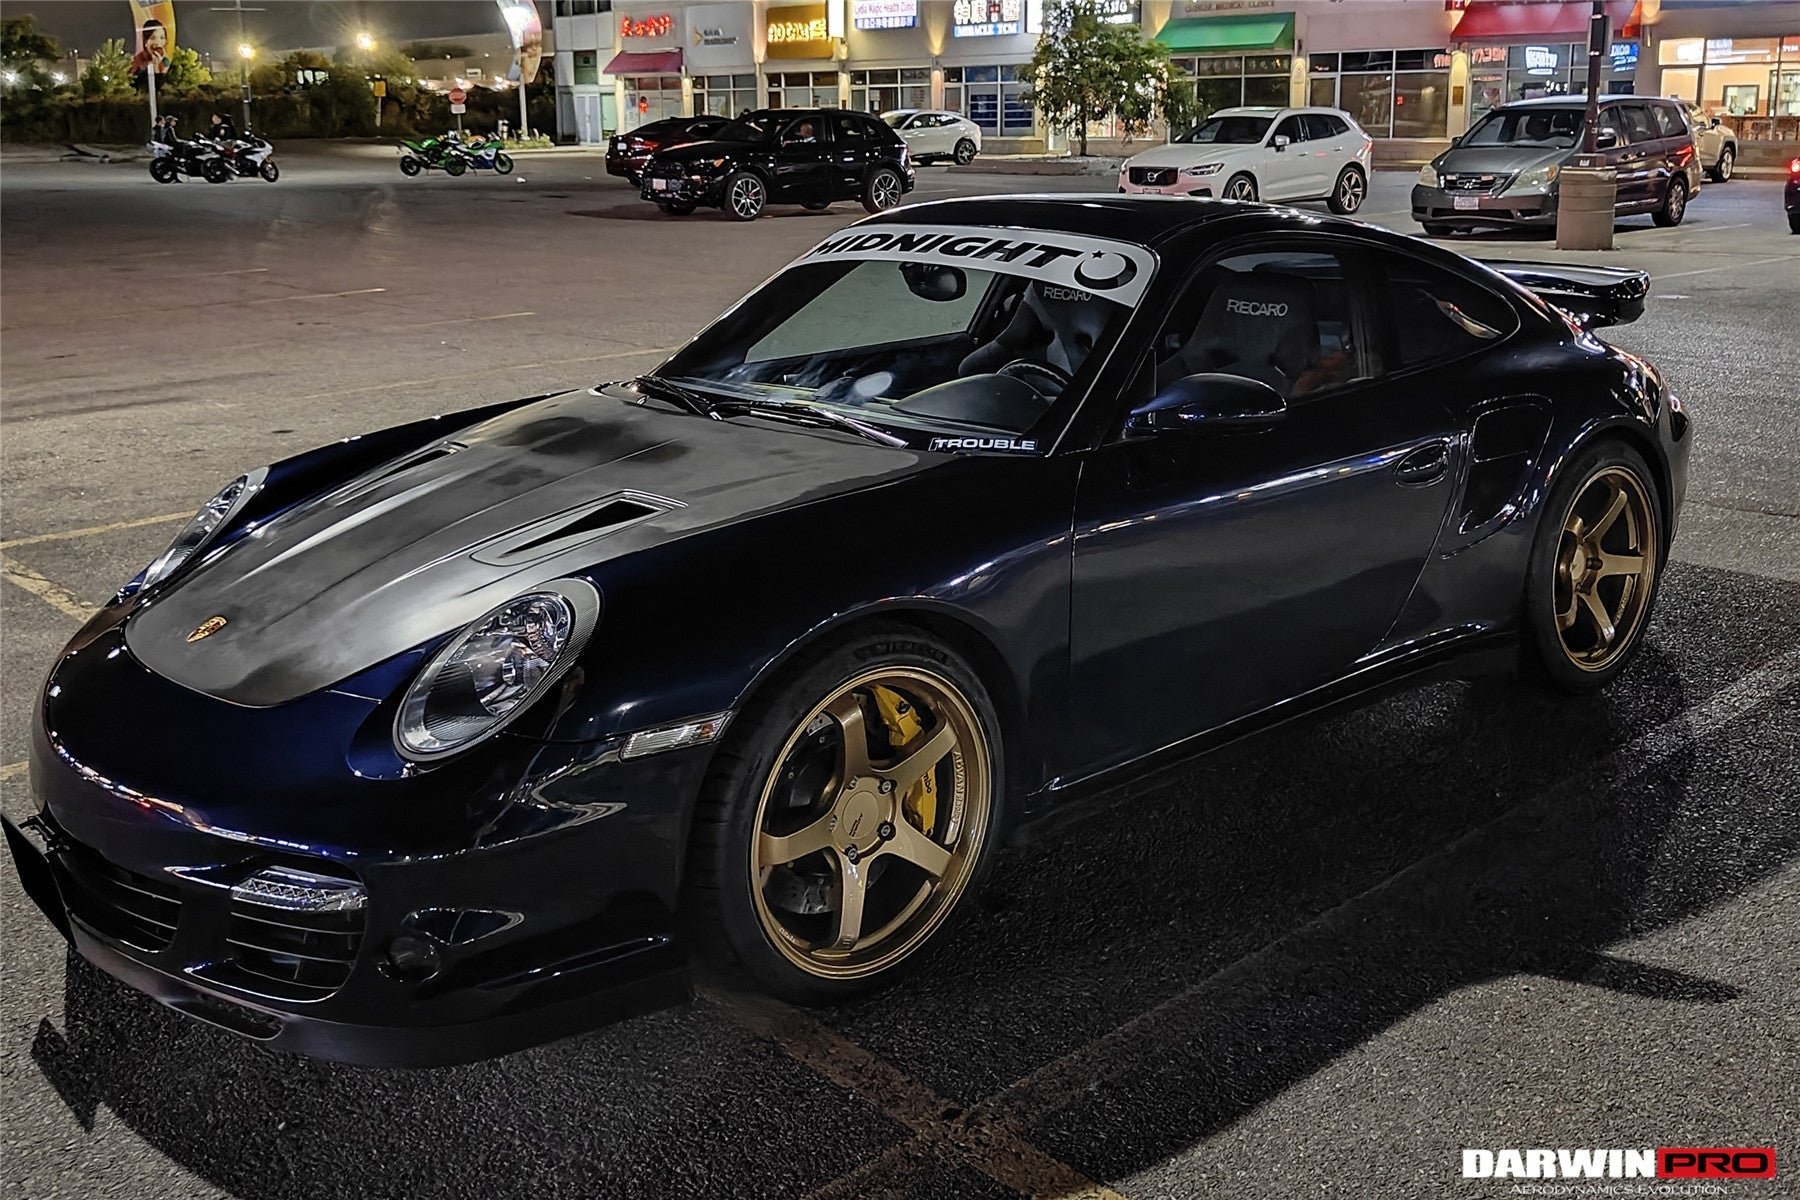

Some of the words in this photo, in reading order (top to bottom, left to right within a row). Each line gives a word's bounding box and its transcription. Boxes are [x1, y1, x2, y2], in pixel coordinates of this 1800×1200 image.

[817, 233, 1085, 268] MIDNIGHT
[1043, 286, 1092, 301] RECARO
[1226, 298, 1288, 317] RECARO
[934, 438, 1036, 451] TROUBLE
